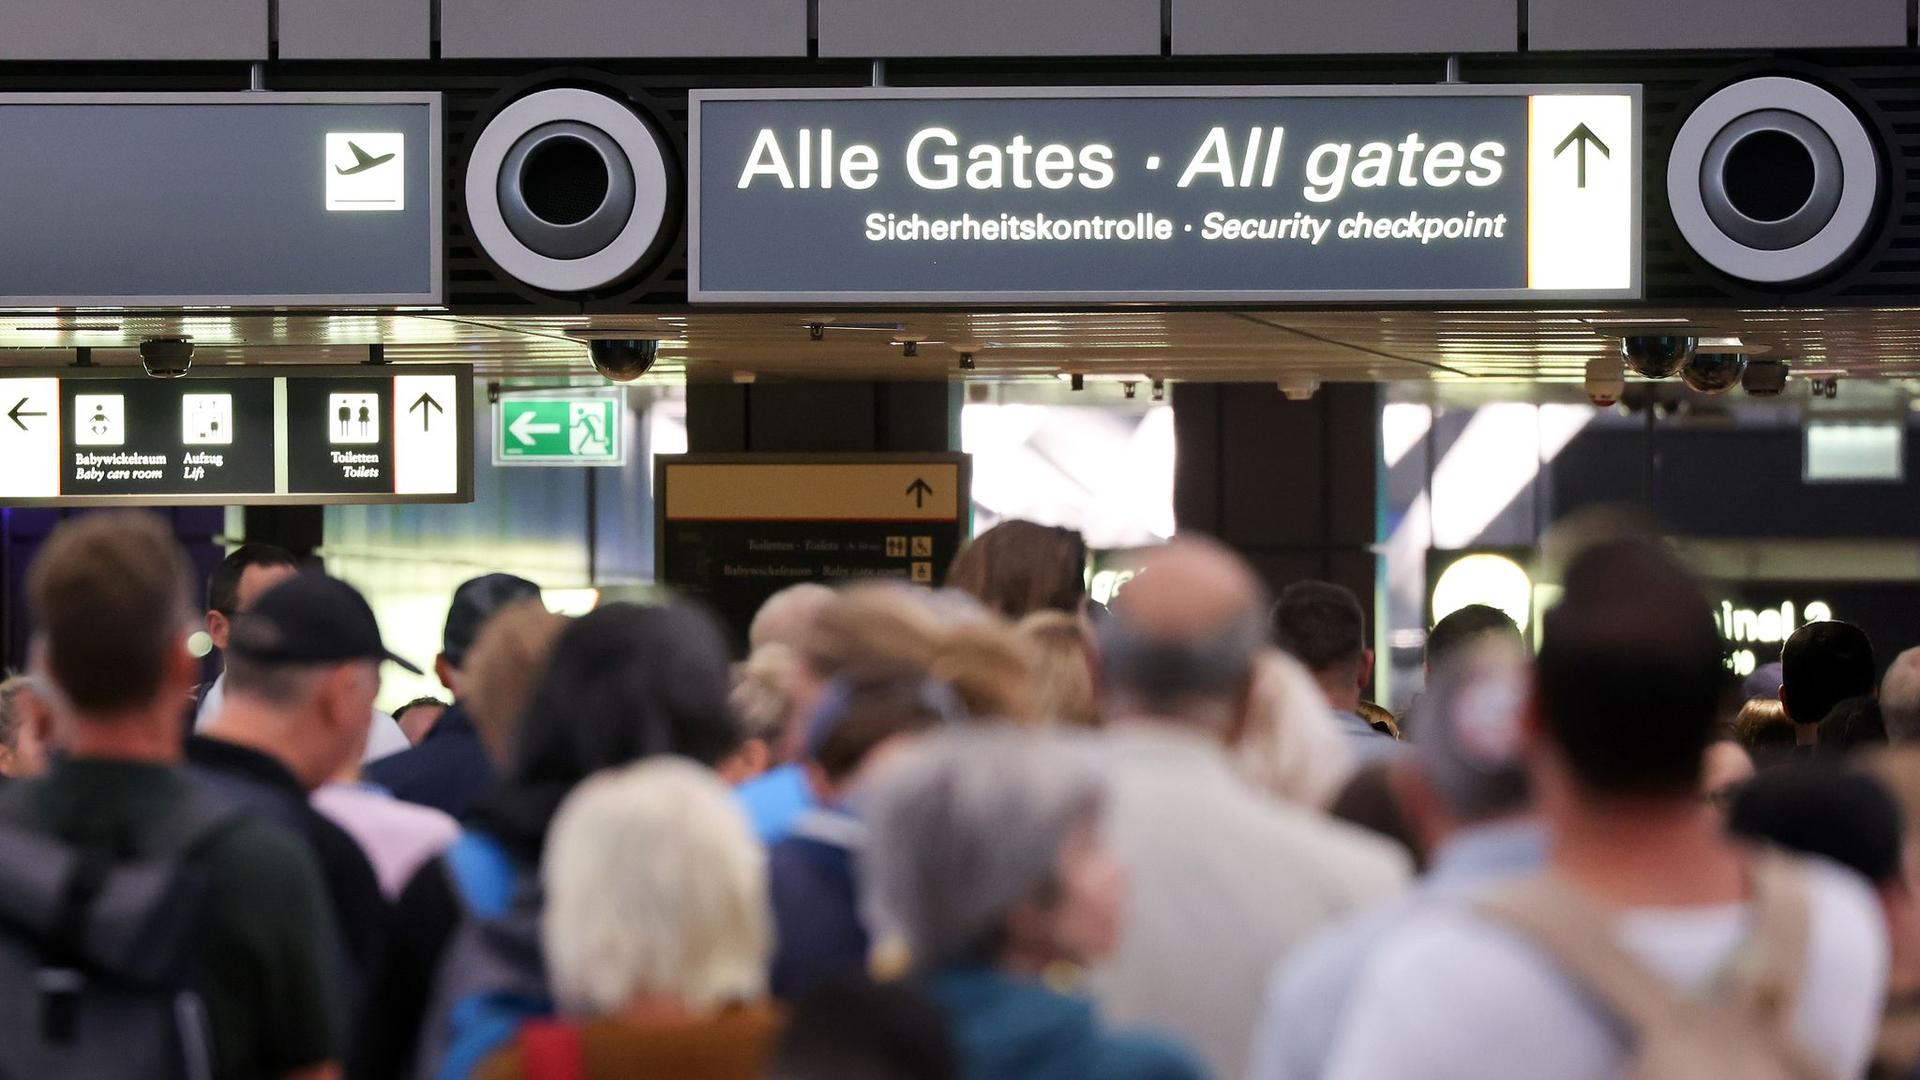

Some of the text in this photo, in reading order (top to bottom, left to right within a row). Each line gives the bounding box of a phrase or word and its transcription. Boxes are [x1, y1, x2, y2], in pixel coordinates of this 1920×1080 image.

[737, 127, 880, 191] Alle
[905, 126, 1116, 191] Gates
[1176, 126, 1286, 189] All
[1303, 131, 1507, 204] gates
[865, 212, 1174, 241] Sicherheitskontrolle
[1201, 211, 1332, 245] Security
[1337, 210, 1508, 245] checkpoint
[75, 452, 167, 467] Babywickelraum
[183, 452, 224, 467] Aufzug
[330, 450, 380, 464] Toiletten
[75, 467, 163, 482] Baby care room
[183, 467, 206, 482] Lift
[342, 465, 380, 479] Toilets
